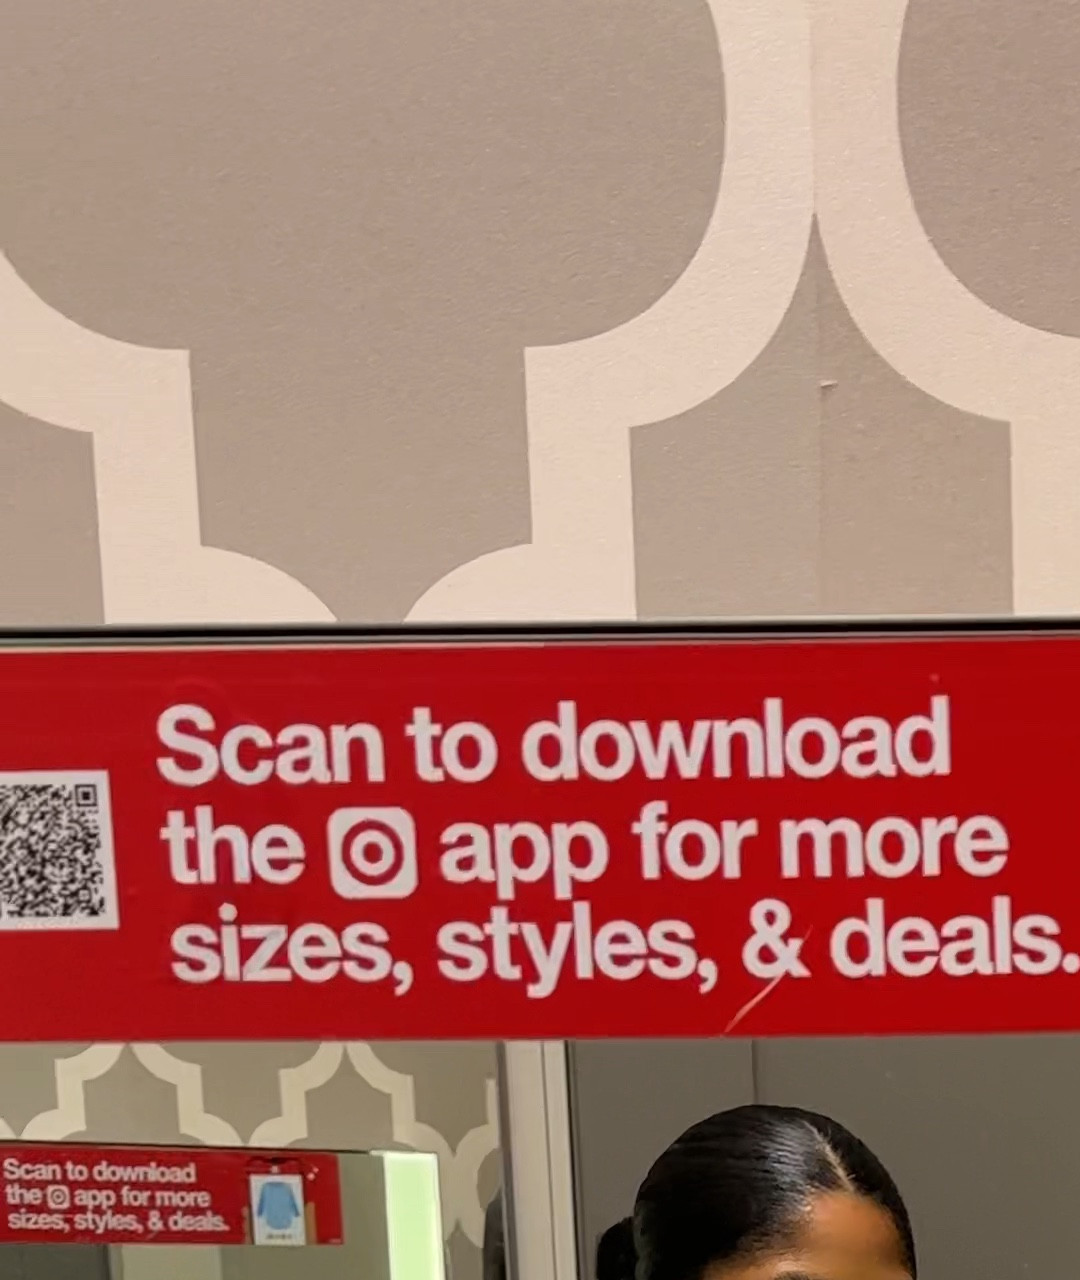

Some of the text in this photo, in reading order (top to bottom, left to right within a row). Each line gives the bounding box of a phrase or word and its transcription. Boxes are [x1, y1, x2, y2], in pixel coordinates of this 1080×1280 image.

[157, 695, 950, 786] Scan to download
[160, 801, 1008, 902] the app for more
[171, 896, 1080, 998] sizes, styles, & deals.
[4, 1158, 195, 1182] Scan to download
[5, 1185, 210, 1209] the app for more
[8, 1210, 228, 1233] sizes, styles, & deals.
